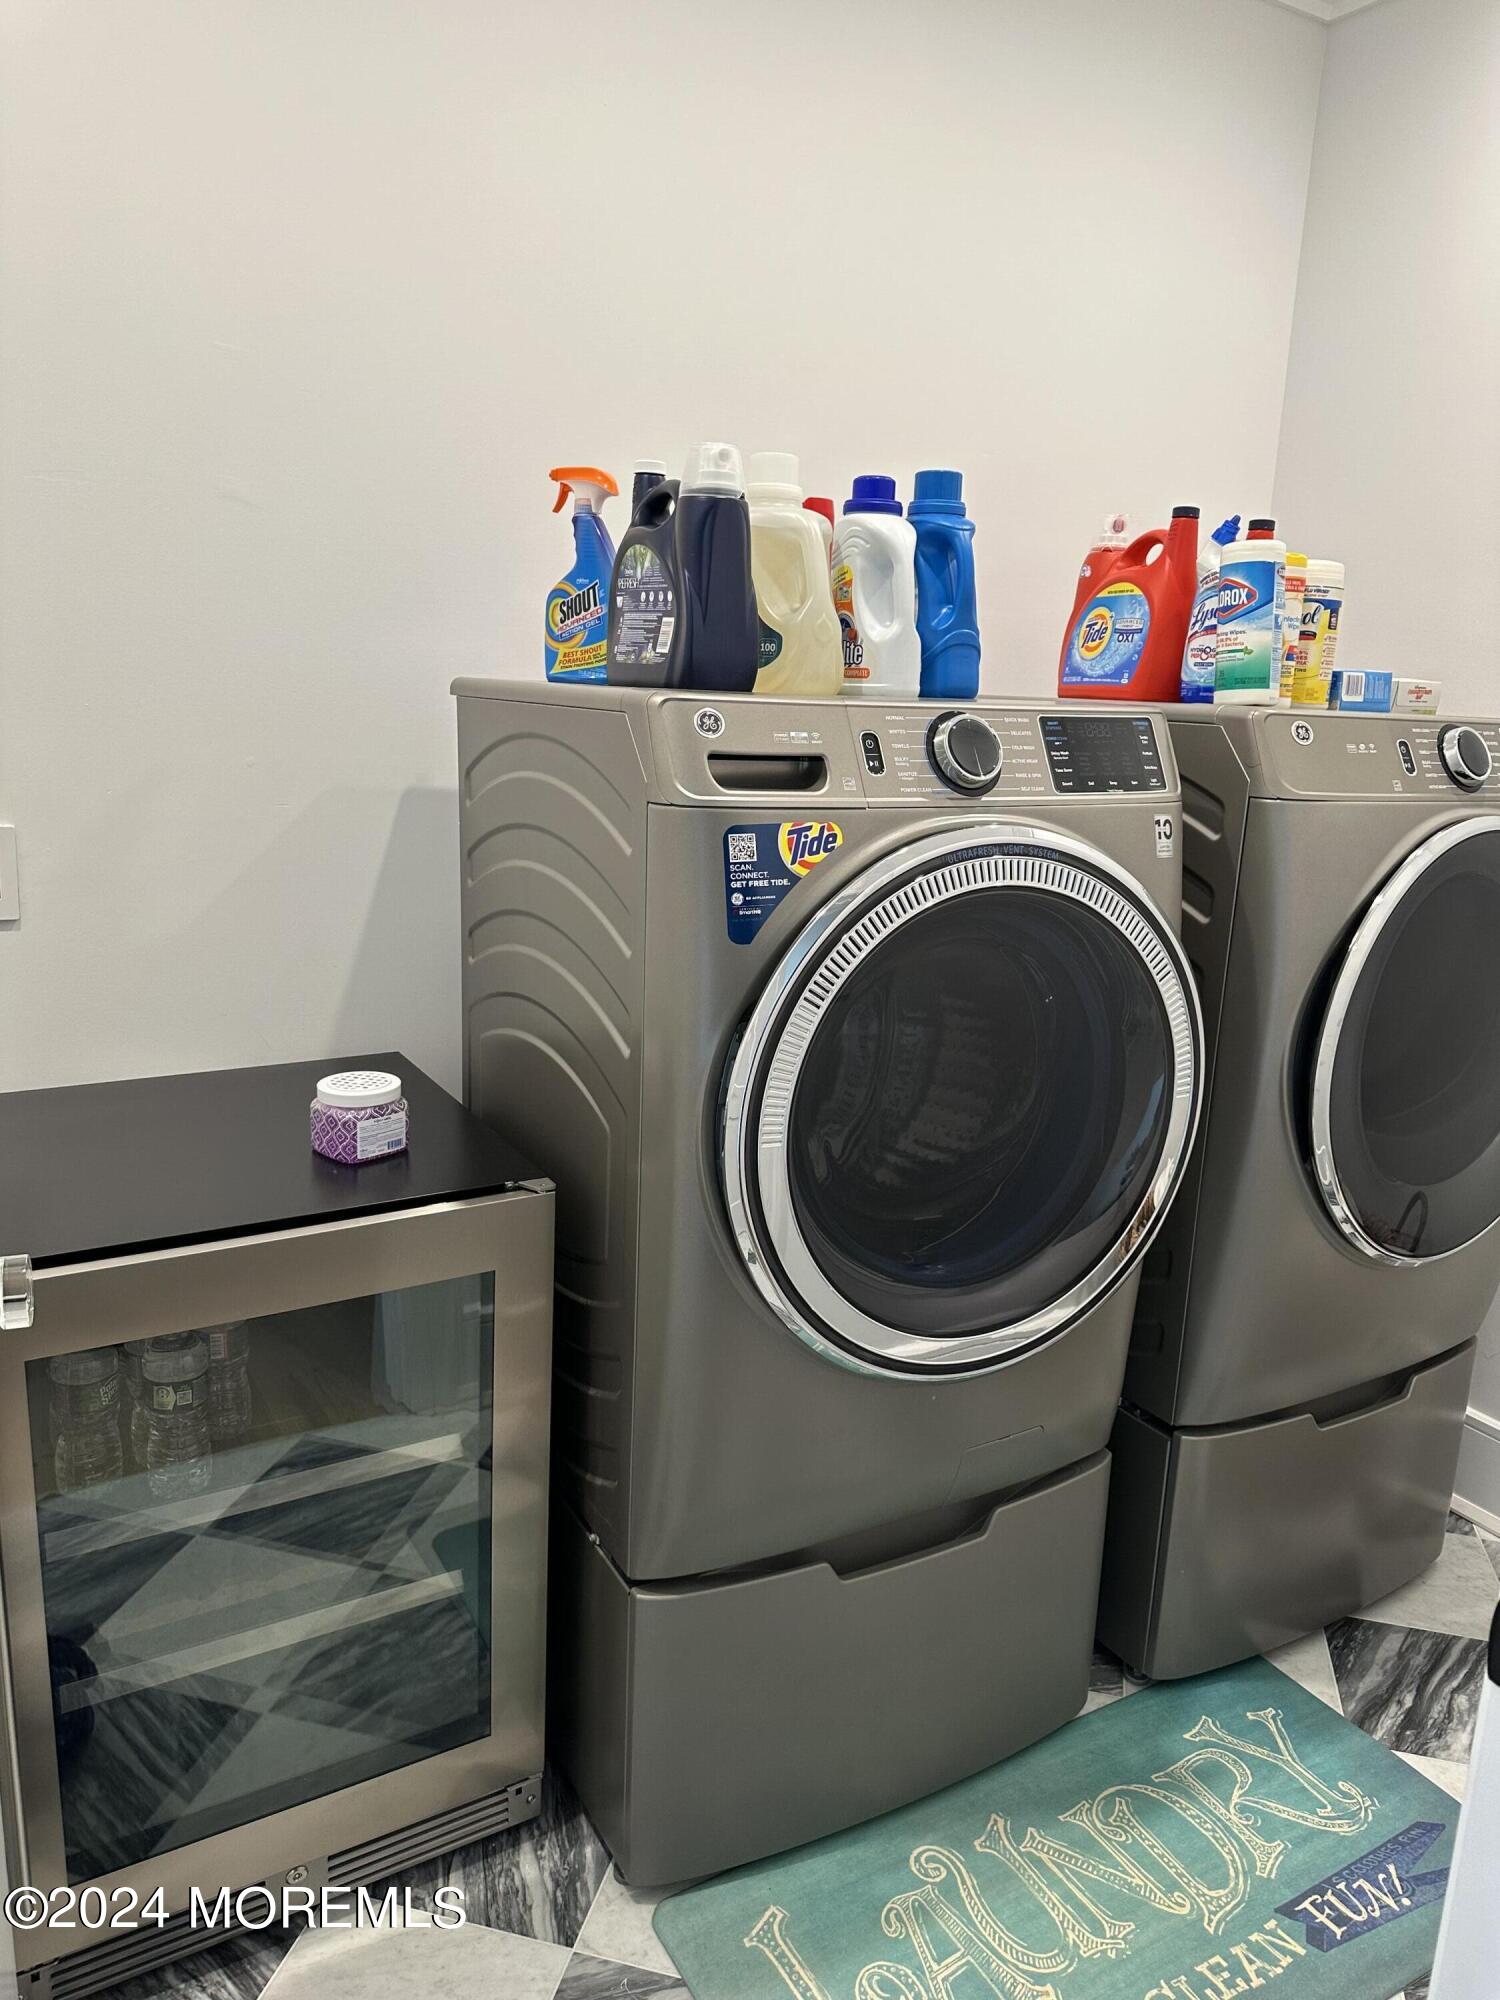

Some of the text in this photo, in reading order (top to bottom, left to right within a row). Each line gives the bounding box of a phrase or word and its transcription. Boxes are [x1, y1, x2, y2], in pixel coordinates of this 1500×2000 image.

[559, 580, 600, 625] SHOUT
[557, 606, 603, 633] ADVANCED
[561, 619, 601, 637] ACTION GEL
[1081, 620, 1109, 649] Tide
[1116, 633, 1135, 643] OXI
[563, 650, 579, 658] BEST
[580, 645, 602, 656] SHOUT
[760, 643, 776, 652] 100
[558, 654, 592, 666] FORMULA
[1154, 818, 1173, 840] 10
[786, 824, 838, 866] Tide
[948, 844, 1060, 864] ULTRAFRESH VENT SYSTEM
[729, 864, 754, 872] SCAN.
[730, 871, 770, 880] CONNECT.
[730, 880, 747, 888] GET
[748, 880, 769, 888] FREE
[1399, 1827, 1427, 1843] PIN
[743, 1707, 1376, 2000] LAUNDRY
[1294, 1862, 1412, 1941] FUN!
